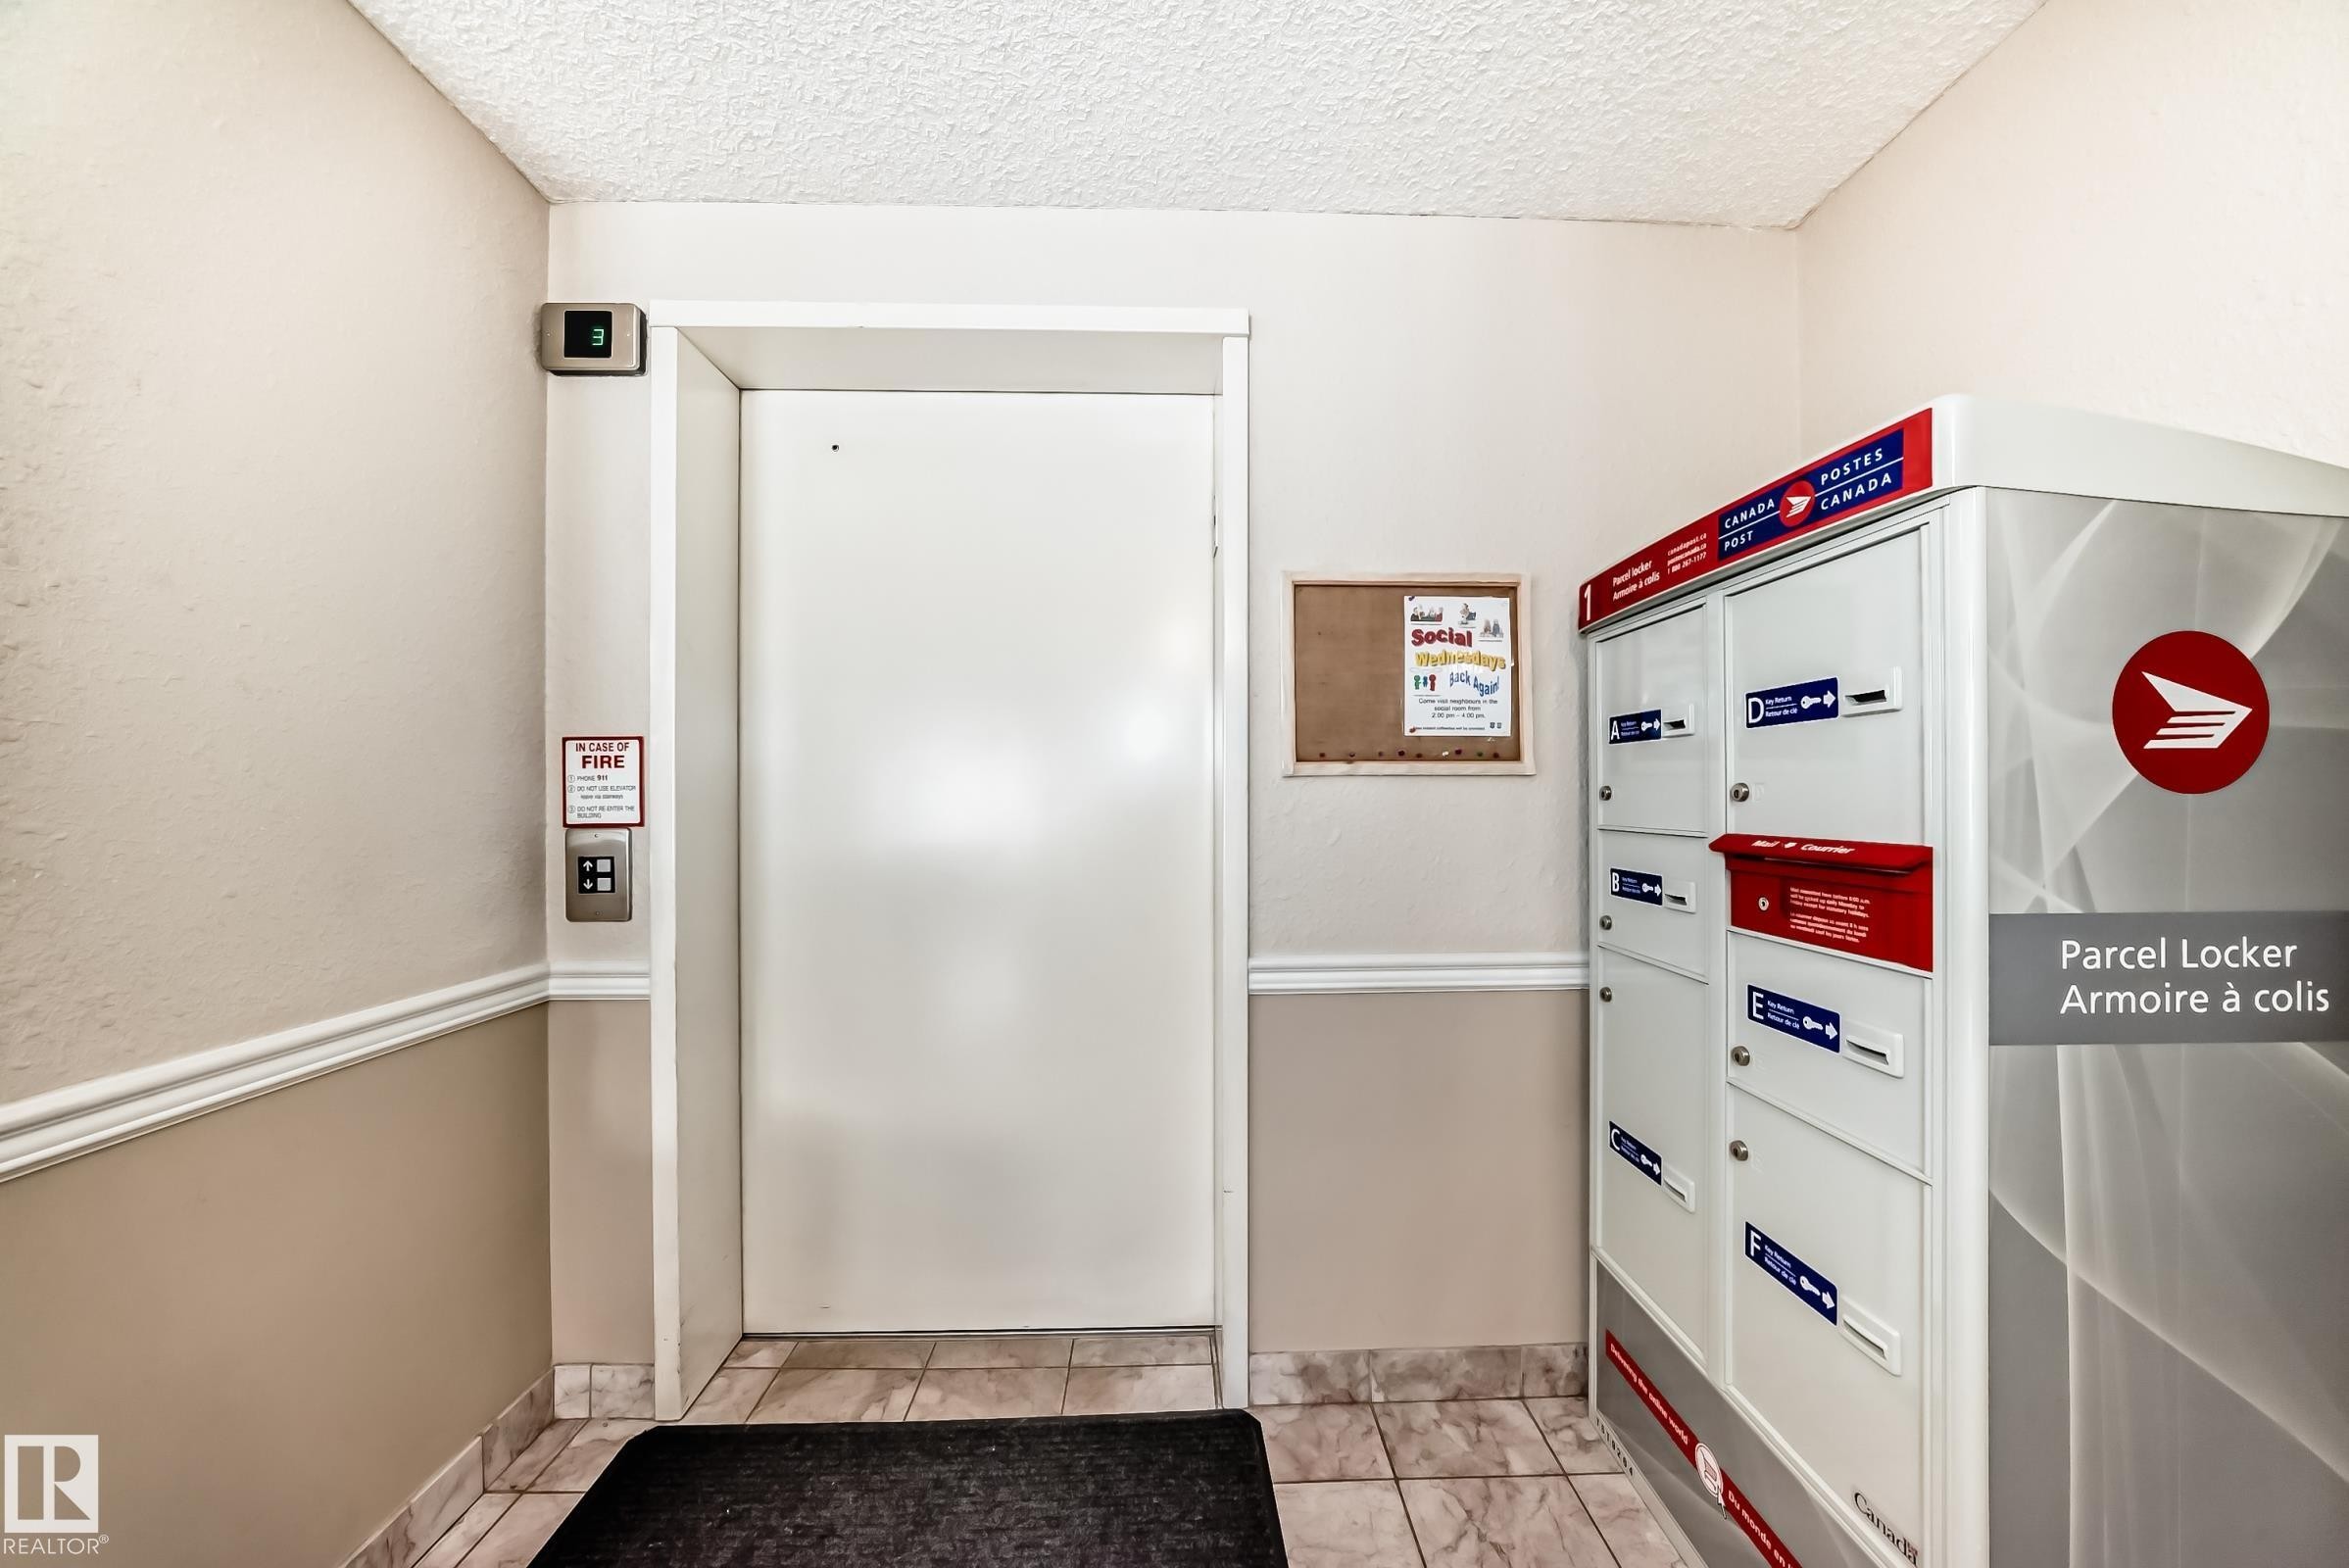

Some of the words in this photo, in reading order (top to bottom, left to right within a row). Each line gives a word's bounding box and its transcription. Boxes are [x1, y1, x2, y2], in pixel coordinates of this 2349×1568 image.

[592, 328, 605, 346] 3
[1821, 448, 1884, 485] POSTES
[1821, 472, 1892, 511] CANADA
[1724, 498, 1775, 529] CANADA
[1667, 533, 1707, 557] canadapost.ca
[1724, 530, 1754, 552] POST
[1682, 552, 1707, 568] 267-1177
[1613, 569, 1631, 587] Parcel
[1632, 561, 1652, 578] locker
[1613, 584, 1638, 602] Armoire
[1639, 578, 1643, 589] à
[1644, 571, 1660, 586] colis
[1584, 584, 1591, 621] 1
[1411, 627, 1473, 648] Social
[1416, 650, 1506, 671] Wednesdays
[1449, 670, 1471, 688] Back
[1473, 675, 1500, 697] Again!
[1748, 697, 1764, 723] D
[1611, 720, 1620, 740] A
[576, 743, 586, 752] IN
[588, 742, 614, 752] CASE
[617, 742, 630, 752] OF
[582, 755, 625, 769] FIRE
[1800, 844, 1855, 855] Courrier
[1612, 872, 1619, 892] B
[2061, 937, 2167, 970] Parcel
[2180, 935, 2298, 969] Locker
[1752, 991, 1764, 1020] E
[1777, 1003, 1795, 1015] Return
[2059, 982, 2209, 1014] Armoire
[2221, 981, 2241, 1013] à
[2254, 980, 2330, 1012] colis
[1768, 1011, 1784, 1023] Retour
[1611, 1128, 1621, 1151] C
[1750, 1230, 1762, 1256] F
[1764, 1256, 1781, 1273] Retour
[1774, 1250, 1791, 1268] Return
[1610, 1343, 1639, 1384] Delivering
[1639, 1378, 1648, 1395] the
[1648, 1392, 1668, 1420] online
[1668, 1415, 1688, 1446] world
[1728, 1490, 1740, 1510] Du
[1741, 1509, 1772, 1550] monde
[1774, 1549, 1786, 1568] en
[1854, 1492, 1918, 1567] Canada
